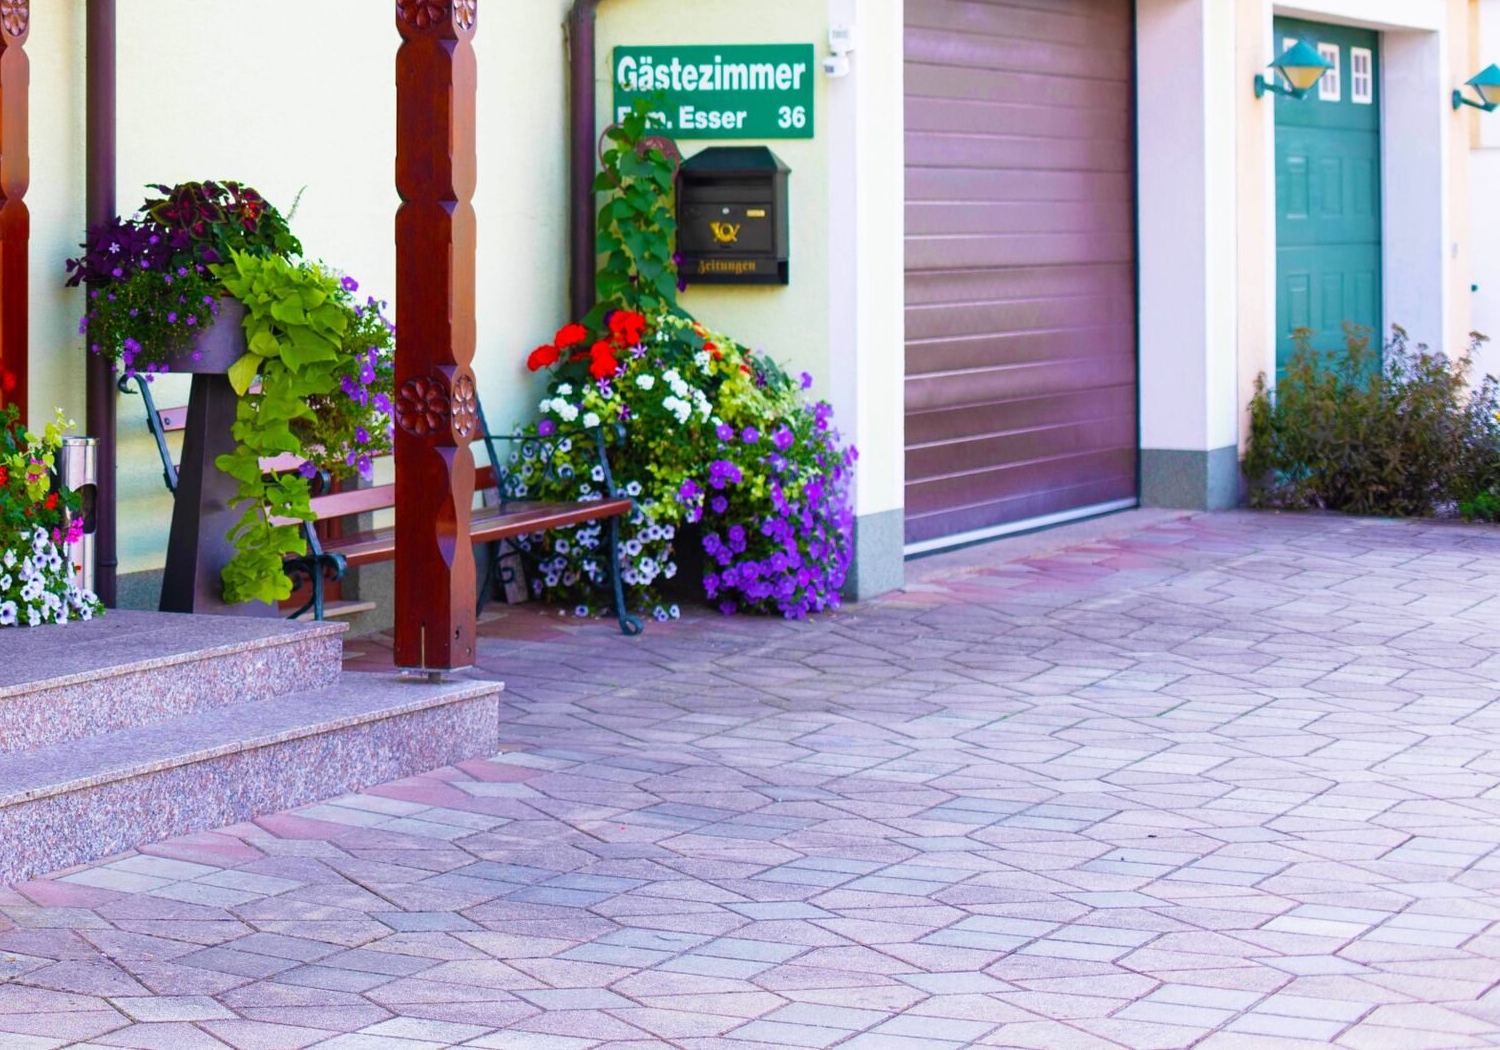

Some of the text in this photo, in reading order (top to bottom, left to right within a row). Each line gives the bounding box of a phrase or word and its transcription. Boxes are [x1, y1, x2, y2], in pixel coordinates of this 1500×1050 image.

[617, 55, 806, 92] Gästezimmer
[617, 105, 806, 130] Fm. Esser 36
[698, 260, 756, 275] Zeitungen
